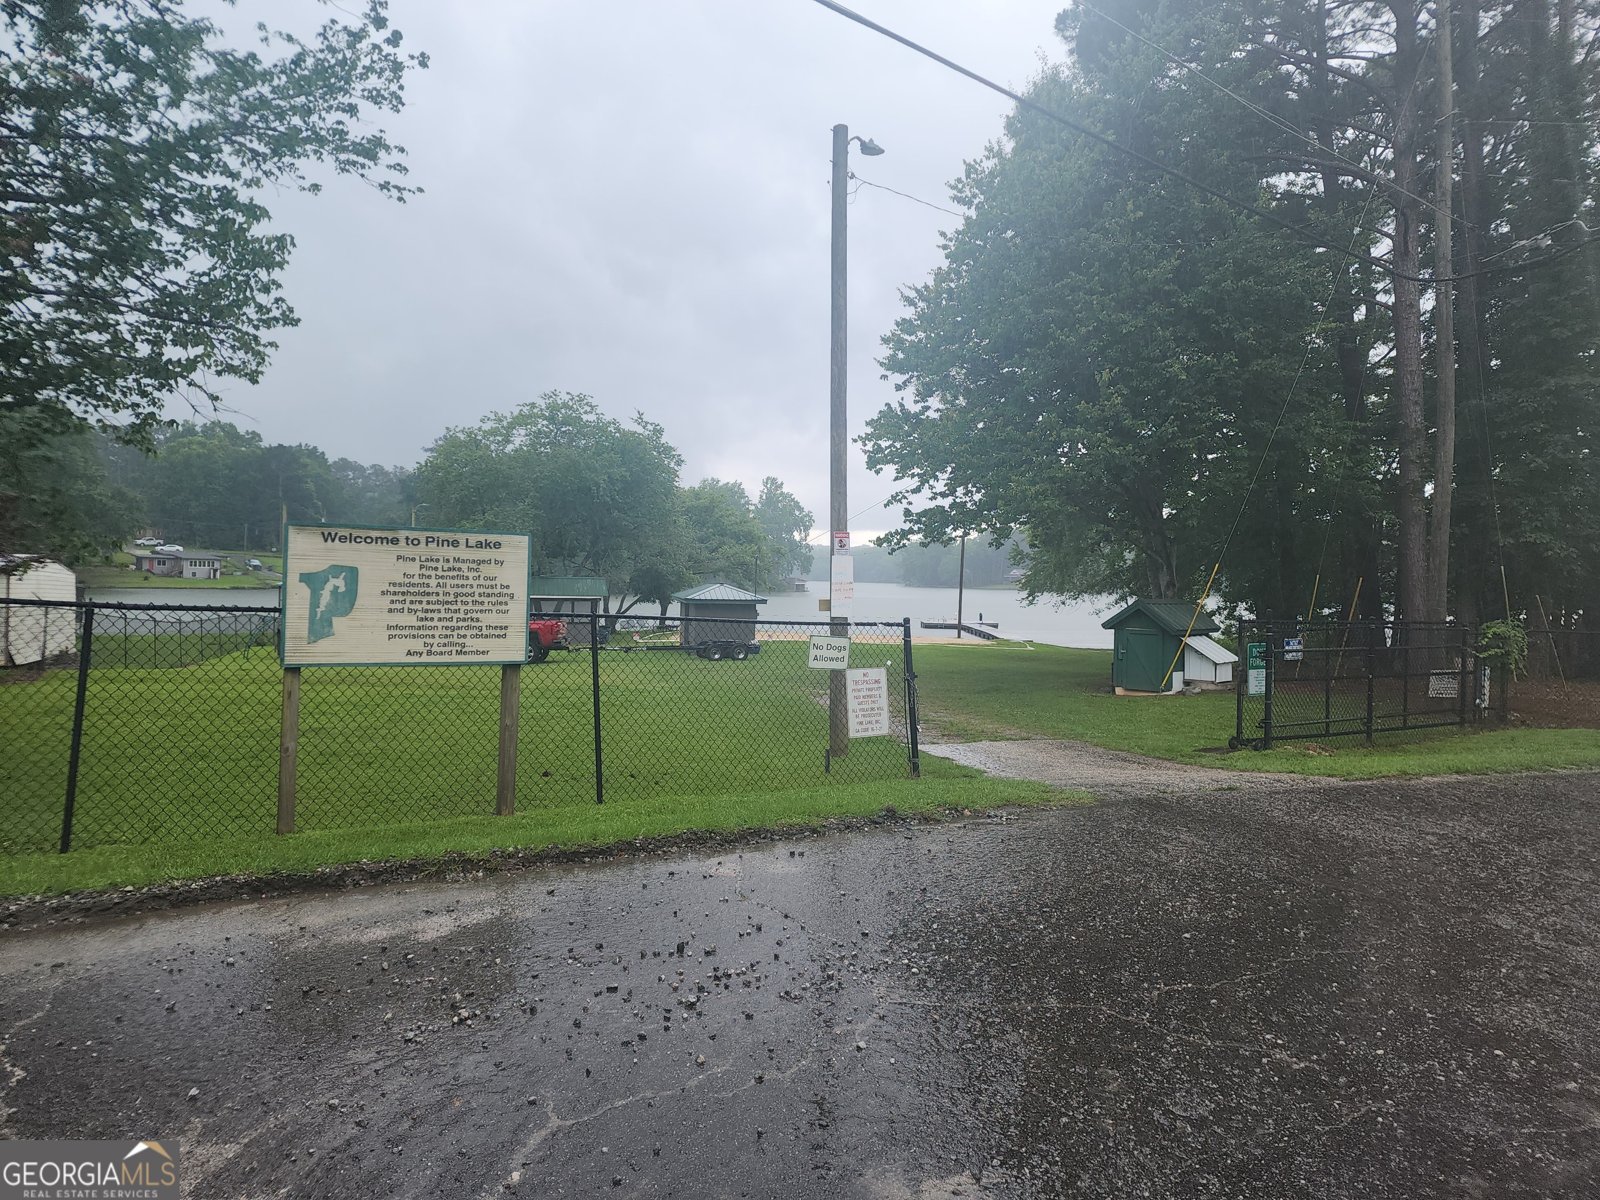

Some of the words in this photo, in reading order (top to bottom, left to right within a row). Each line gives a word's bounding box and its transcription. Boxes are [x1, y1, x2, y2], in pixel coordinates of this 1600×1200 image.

[321, 532, 400, 546] Welcome
[405, 536, 420, 546] to
[425, 536, 460, 548] Pine
[465, 538, 502, 550] Lake
[453, 557, 491, 566] Managed
[827, 644, 846, 653] Dogs
